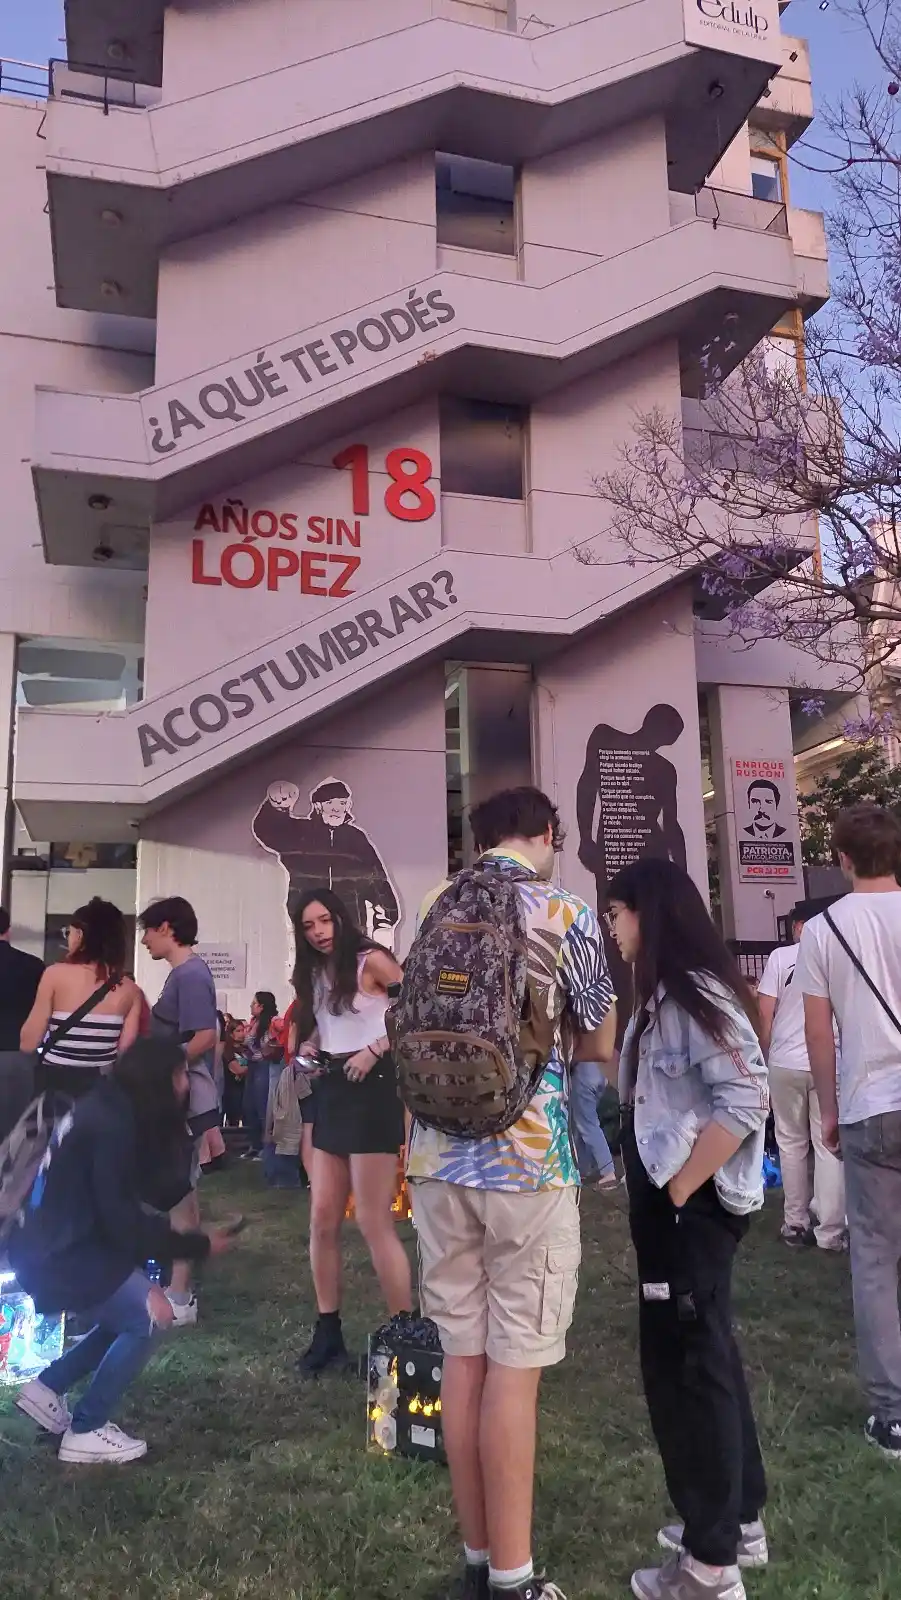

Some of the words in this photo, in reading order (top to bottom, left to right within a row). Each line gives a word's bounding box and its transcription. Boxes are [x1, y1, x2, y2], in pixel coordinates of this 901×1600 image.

[148, 398, 205, 453] ¿A
[198, 351, 289, 422] QUÉ
[281, 339, 339, 384] TE
[330, 288, 456, 365] PODÉS
[332, 443, 437, 523] 18
[193, 498, 299, 542] AÑOS
[306, 515, 362, 549] SIN
[191, 536, 362, 598] LÓPEZ
[136, 570, 459, 768] ACOSTUMBRAR?
[735, 760, 785, 771] ENRIQUE
[736, 769, 785, 779] RUSCONI
[743, 846, 793, 857] PATRIOTA,
